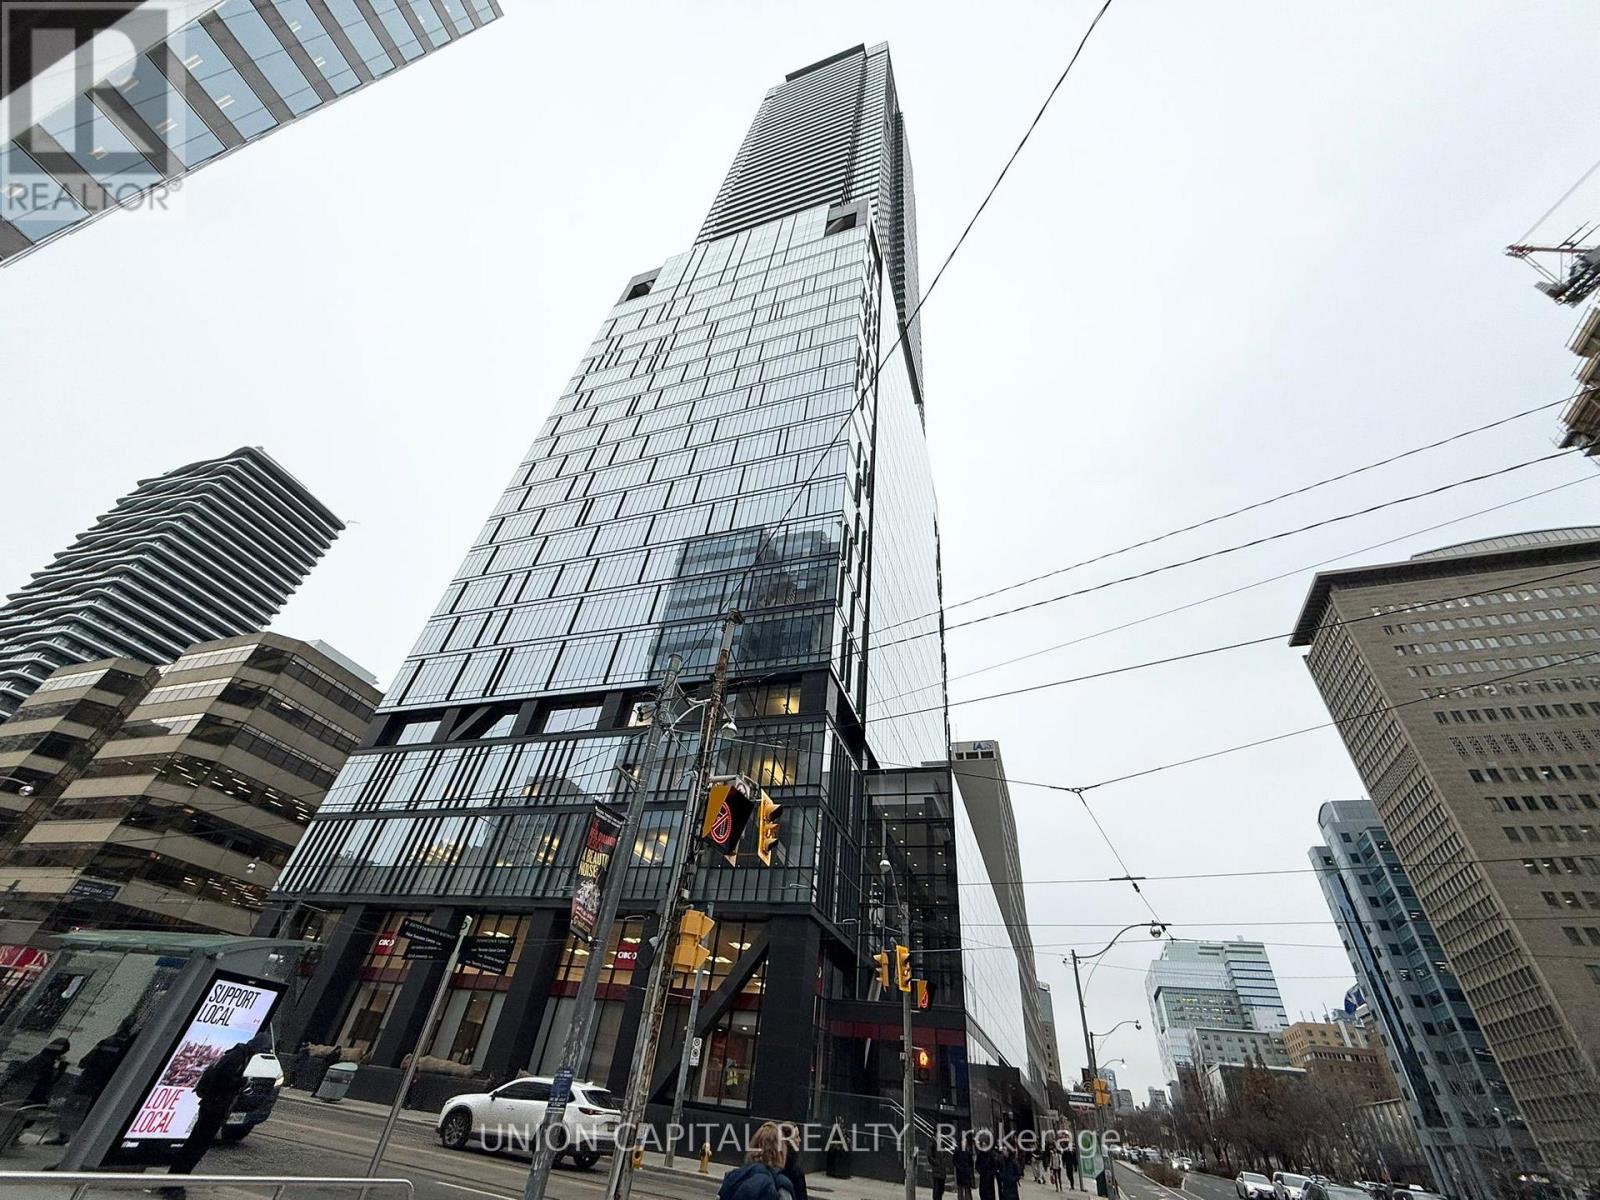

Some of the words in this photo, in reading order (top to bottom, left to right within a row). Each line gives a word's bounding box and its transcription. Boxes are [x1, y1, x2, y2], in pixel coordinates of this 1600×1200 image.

[209, 984, 262, 1010] SUPPORT
[196, 1003, 235, 1026] LOCAL
[144, 1088, 185, 1110] LOVE
[130, 1110, 176, 1133] LOCAL
